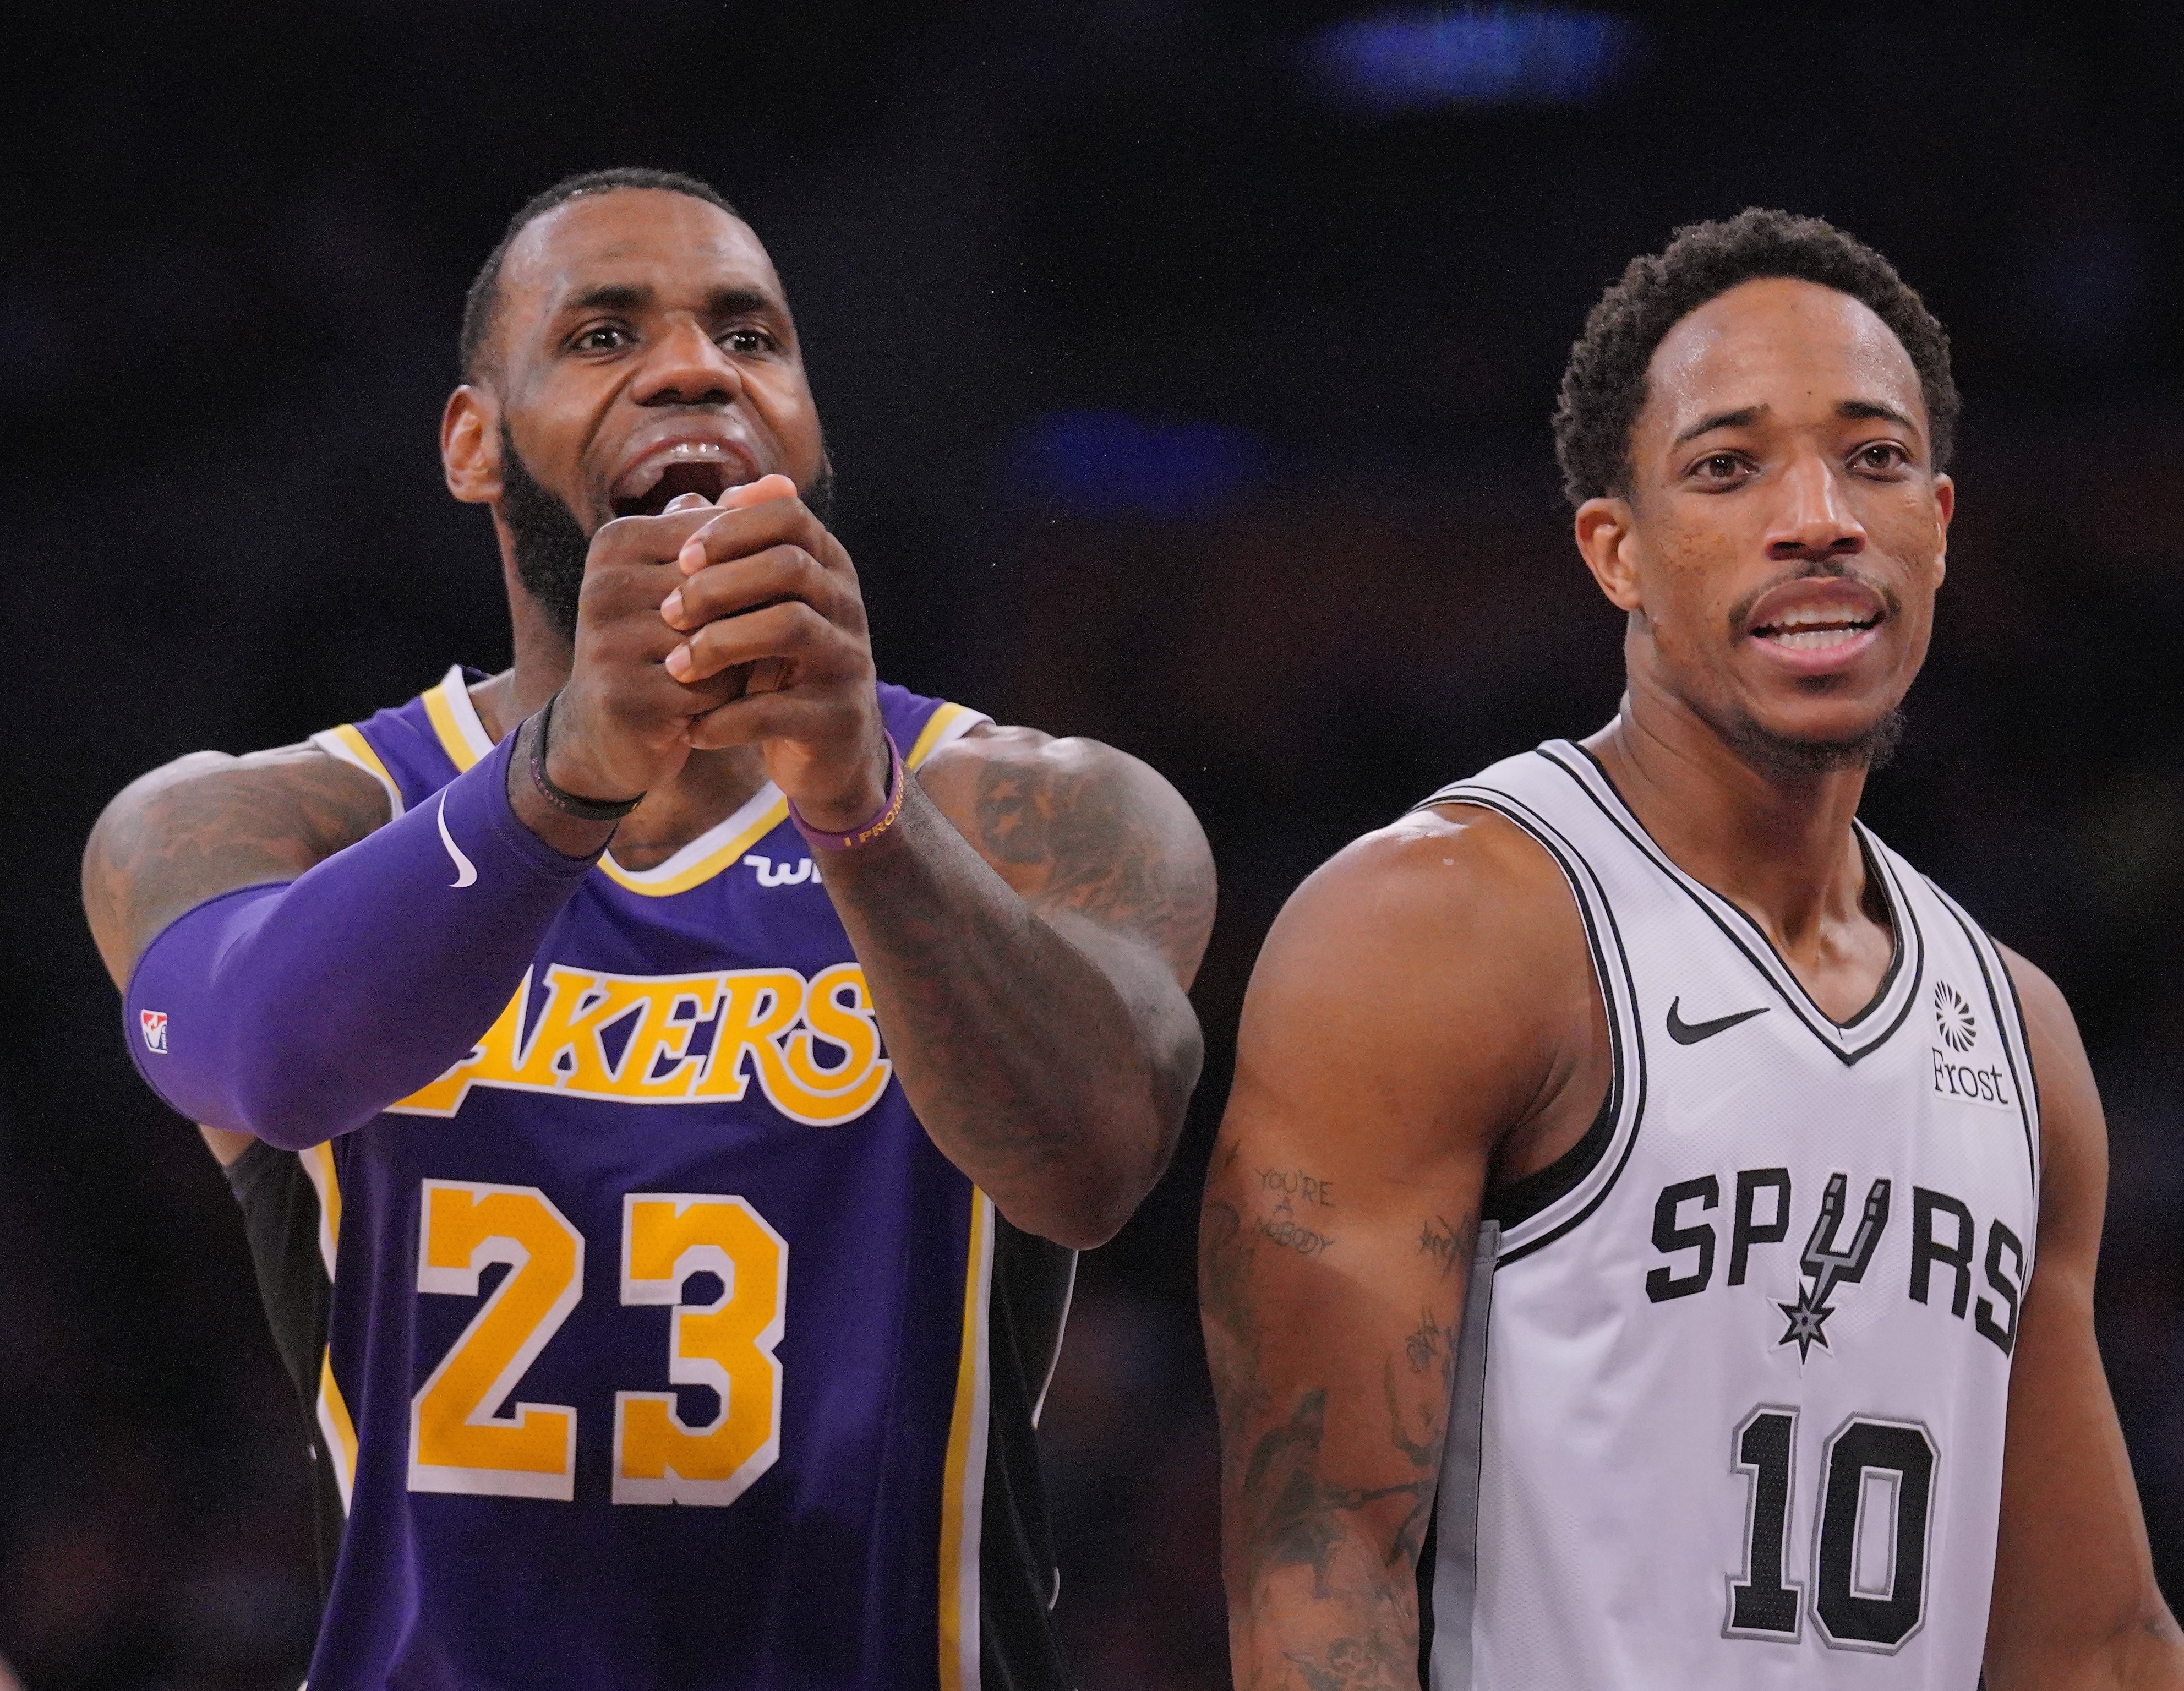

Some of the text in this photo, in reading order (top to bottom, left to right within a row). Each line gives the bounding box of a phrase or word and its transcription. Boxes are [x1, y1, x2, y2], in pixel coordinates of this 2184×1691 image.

[382, 962, 893, 1127] AKERS
[1931, 1047, 2008, 1105] Frost
[407, 1178, 789, 1507] 23
[1645, 1168, 2023, 1365] SPURS
[1721, 1401, 1942, 1657] 10
